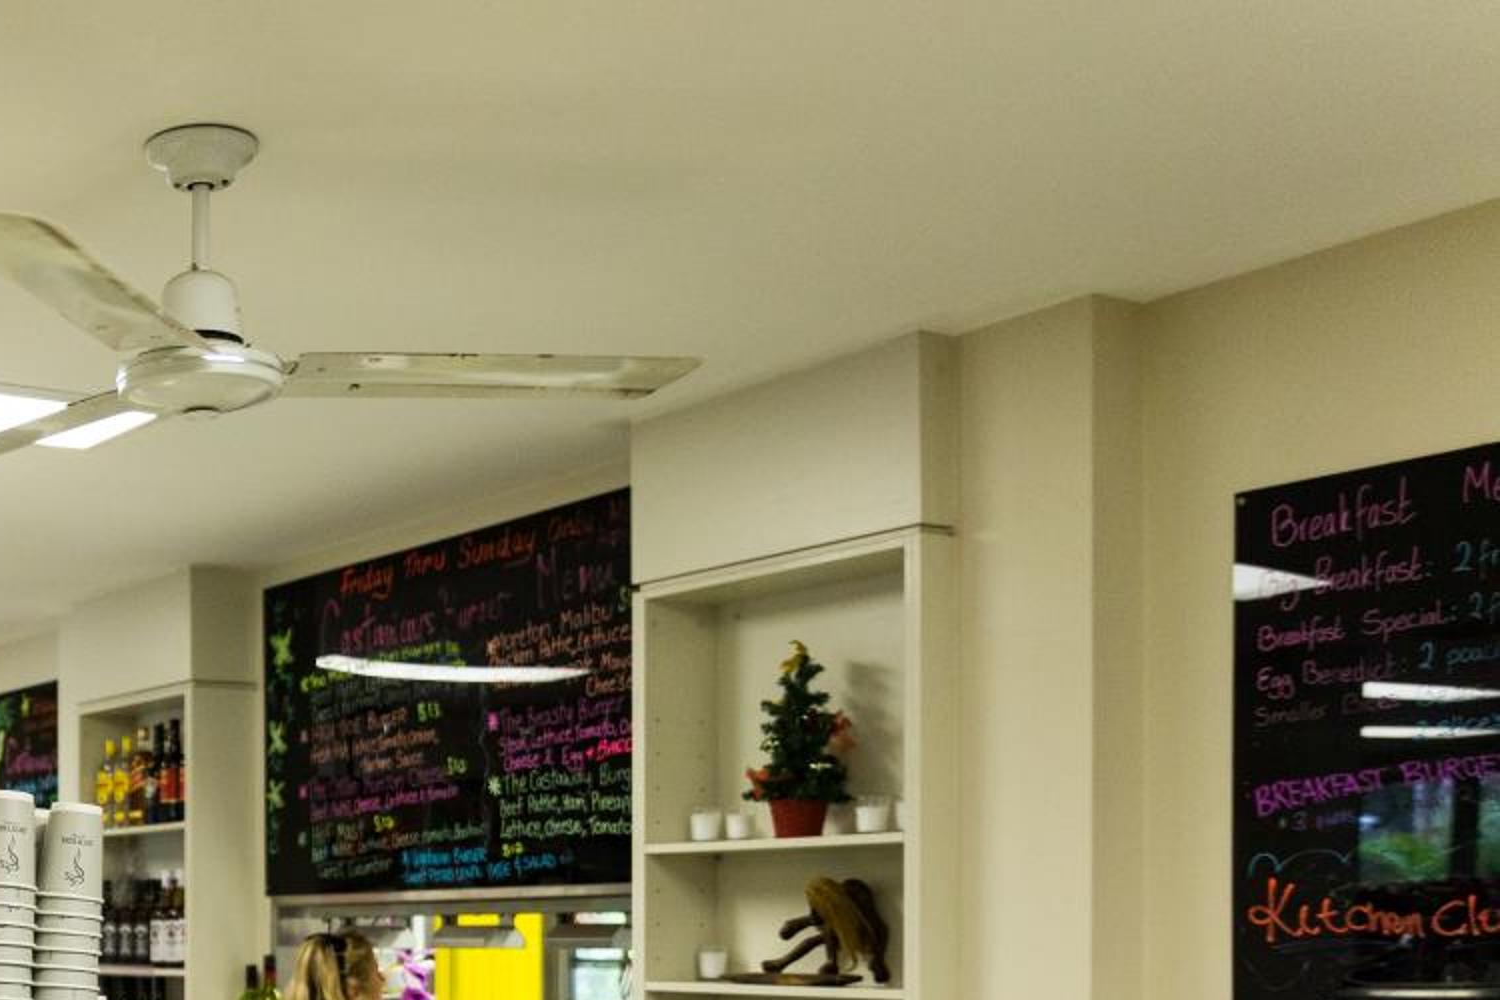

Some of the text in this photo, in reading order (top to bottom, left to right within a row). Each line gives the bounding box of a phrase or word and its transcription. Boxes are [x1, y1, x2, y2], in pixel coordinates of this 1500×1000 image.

[1271, 475, 1417, 548] Breakfast
[457, 526, 537, 570] Sunday
[1255, 614, 1348, 653] Breakfast
[1255, 665, 1297, 701] Egg
[1253, 768, 1381, 818] BREAKFAST
